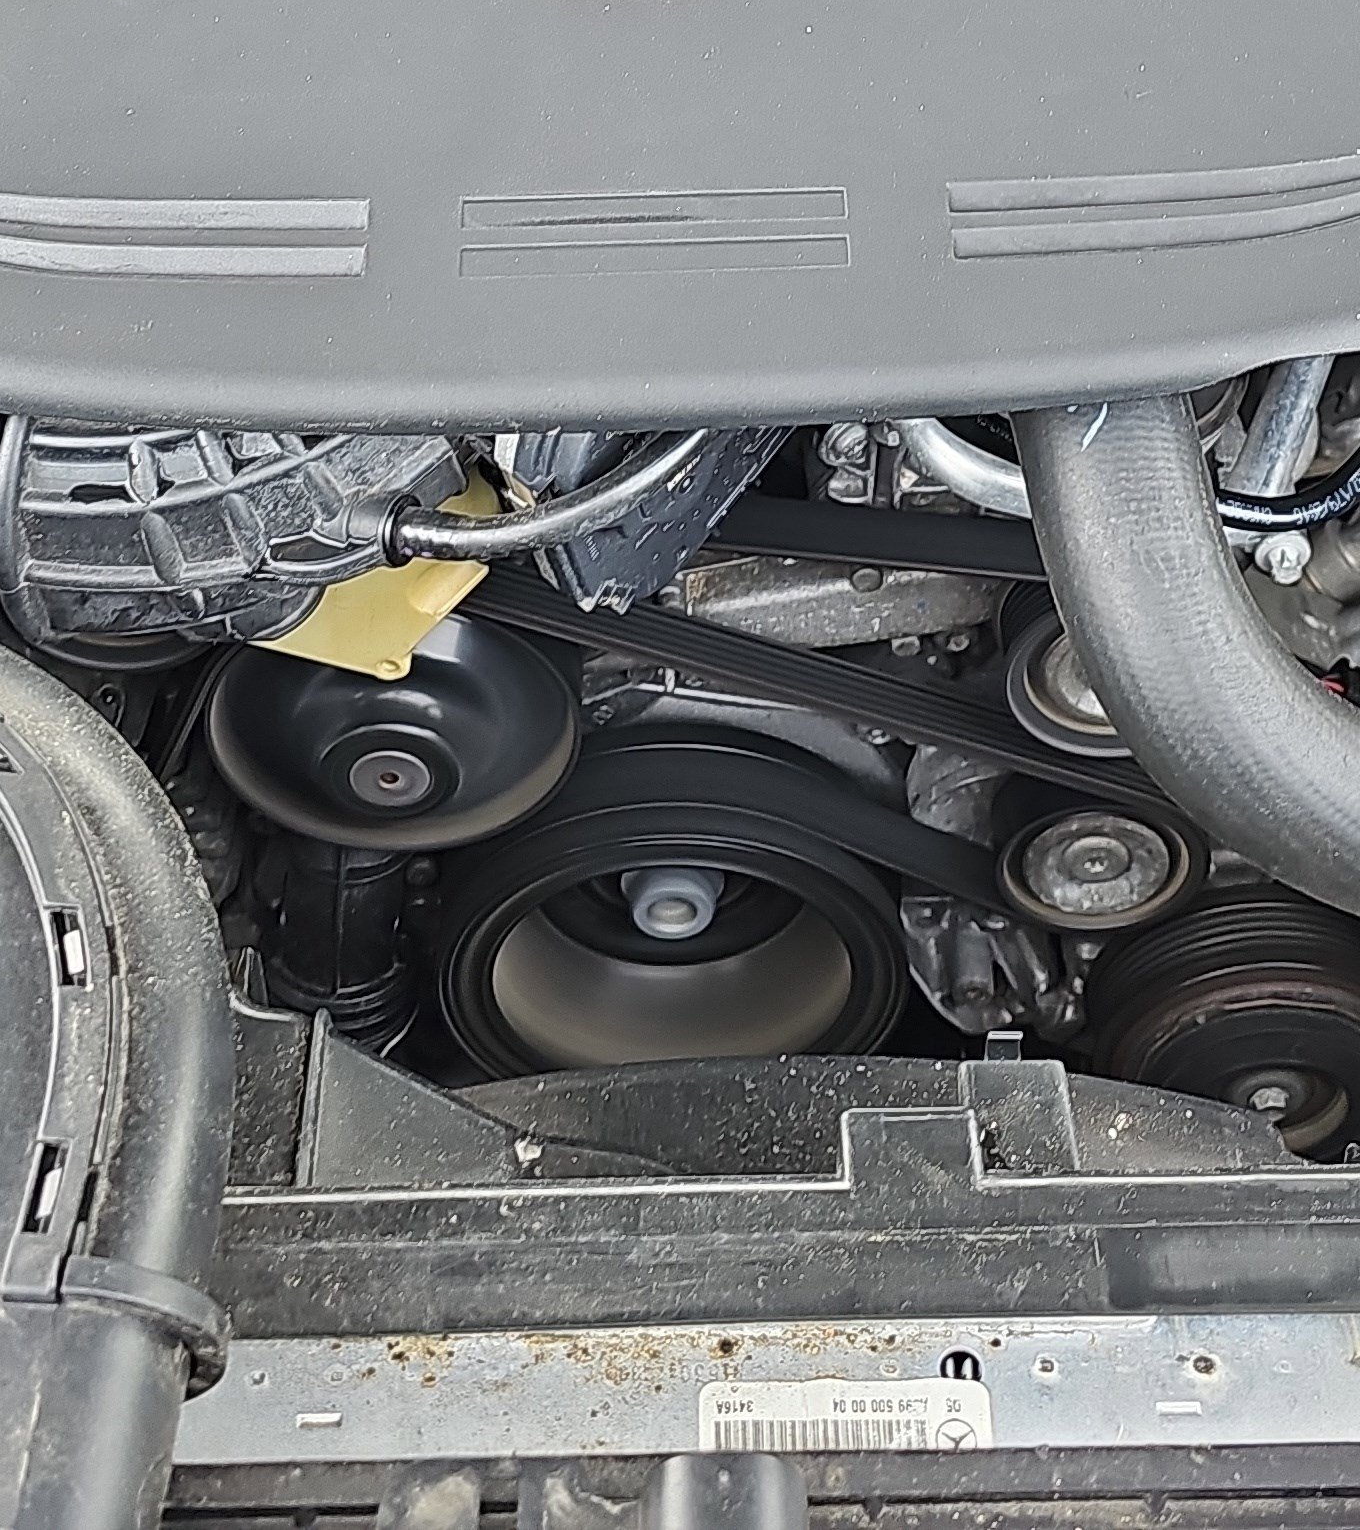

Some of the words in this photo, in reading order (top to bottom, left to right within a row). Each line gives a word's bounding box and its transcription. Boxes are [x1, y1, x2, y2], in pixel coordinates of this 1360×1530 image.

[715, 1399, 755, 1414] 3416A
[832, 1397, 847, 1413] 04
[851, 1398, 867, 1413] 00
[871, 1398, 893, 1413] 500
